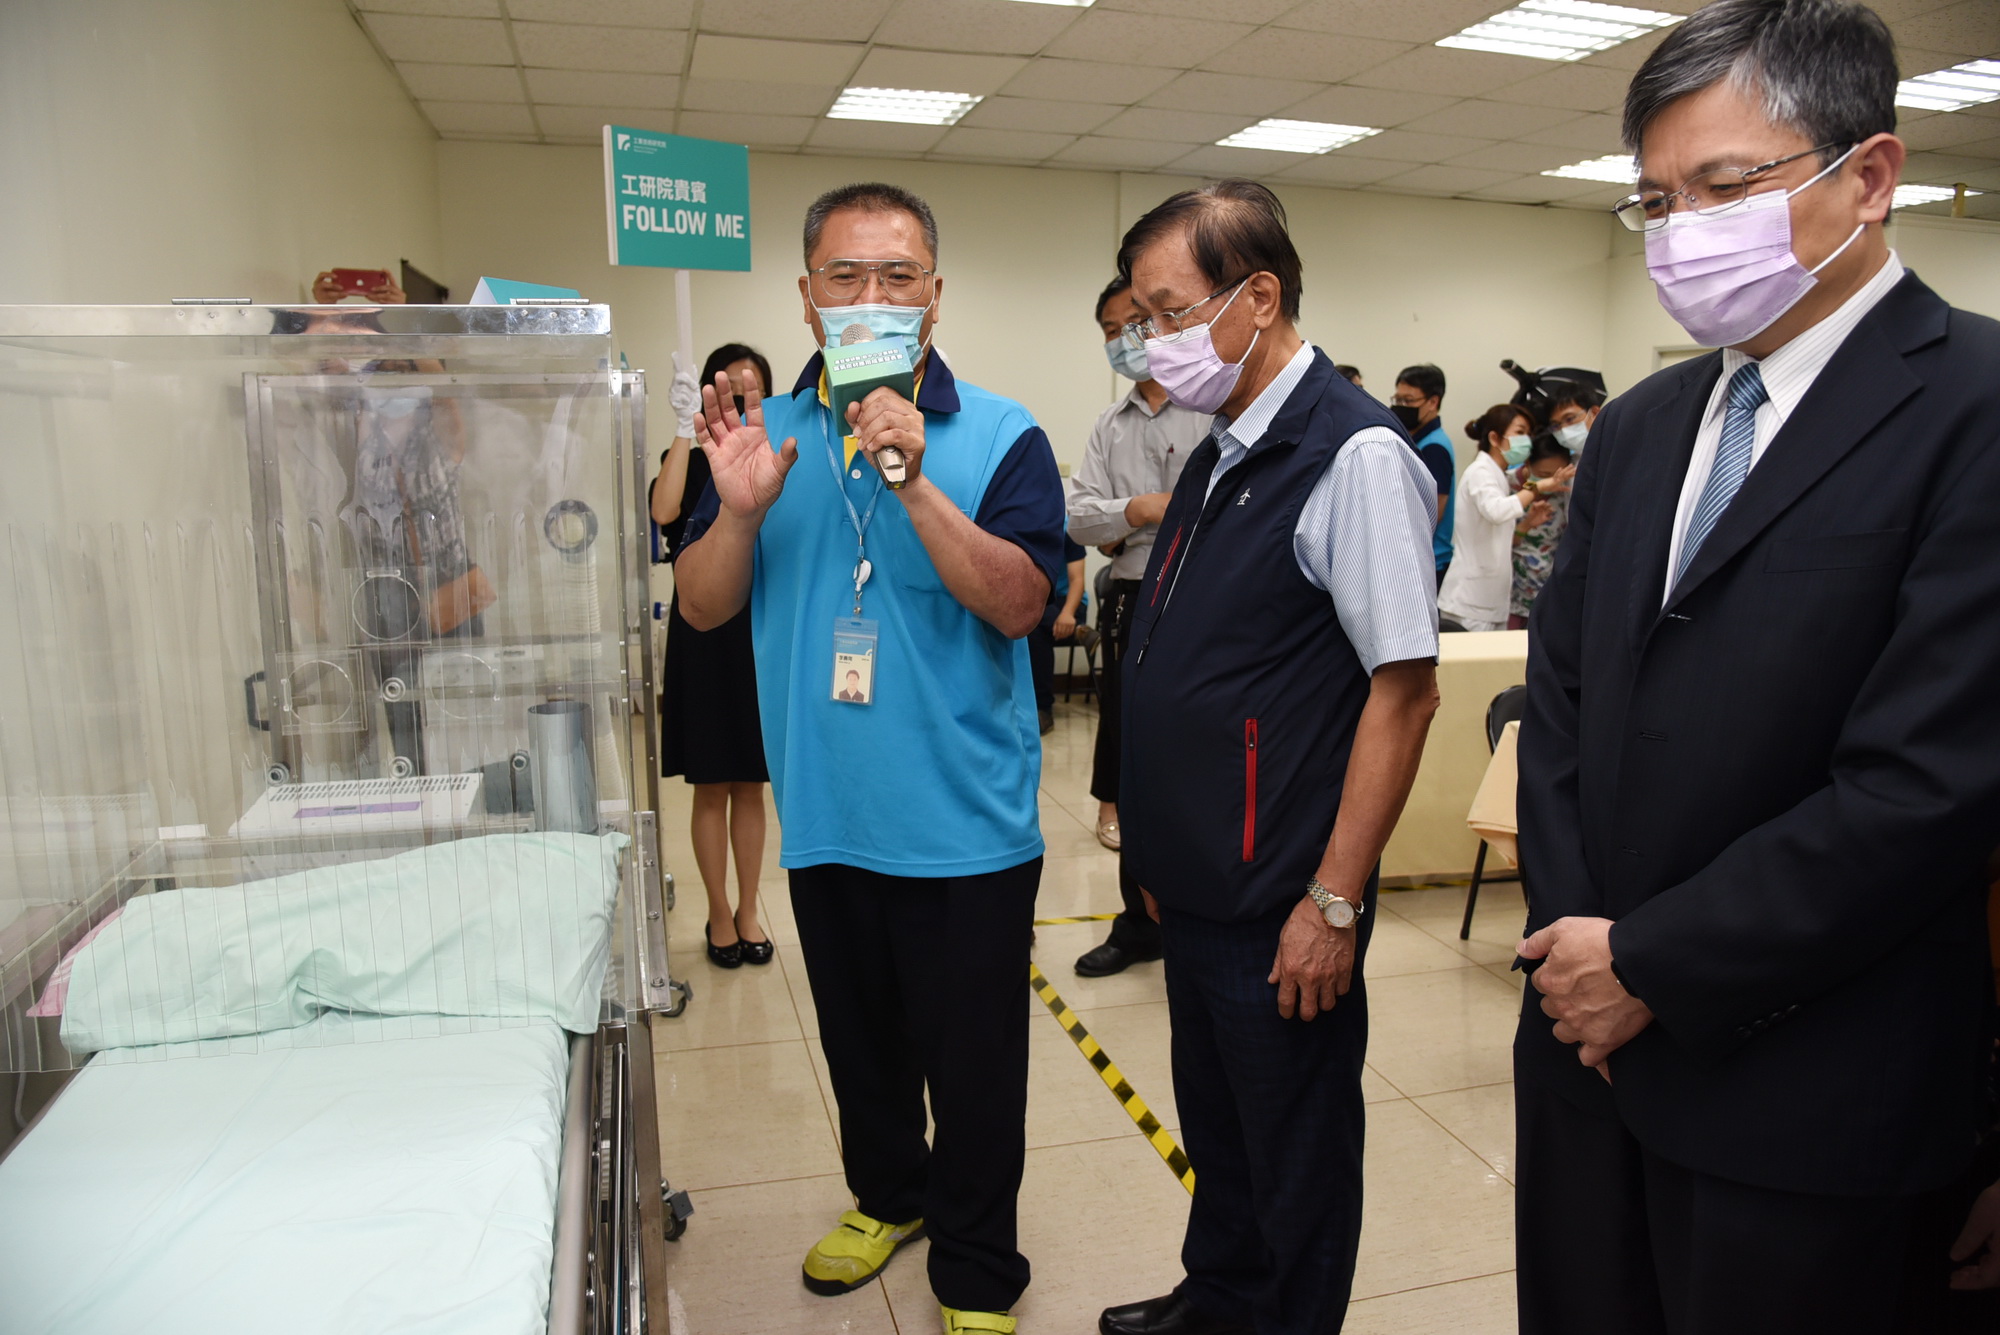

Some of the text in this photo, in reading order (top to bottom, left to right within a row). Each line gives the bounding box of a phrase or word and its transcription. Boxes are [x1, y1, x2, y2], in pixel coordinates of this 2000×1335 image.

[621, 174, 707, 204] 工研院貴賓
[623, 204, 745, 239] FOLLOW ME
